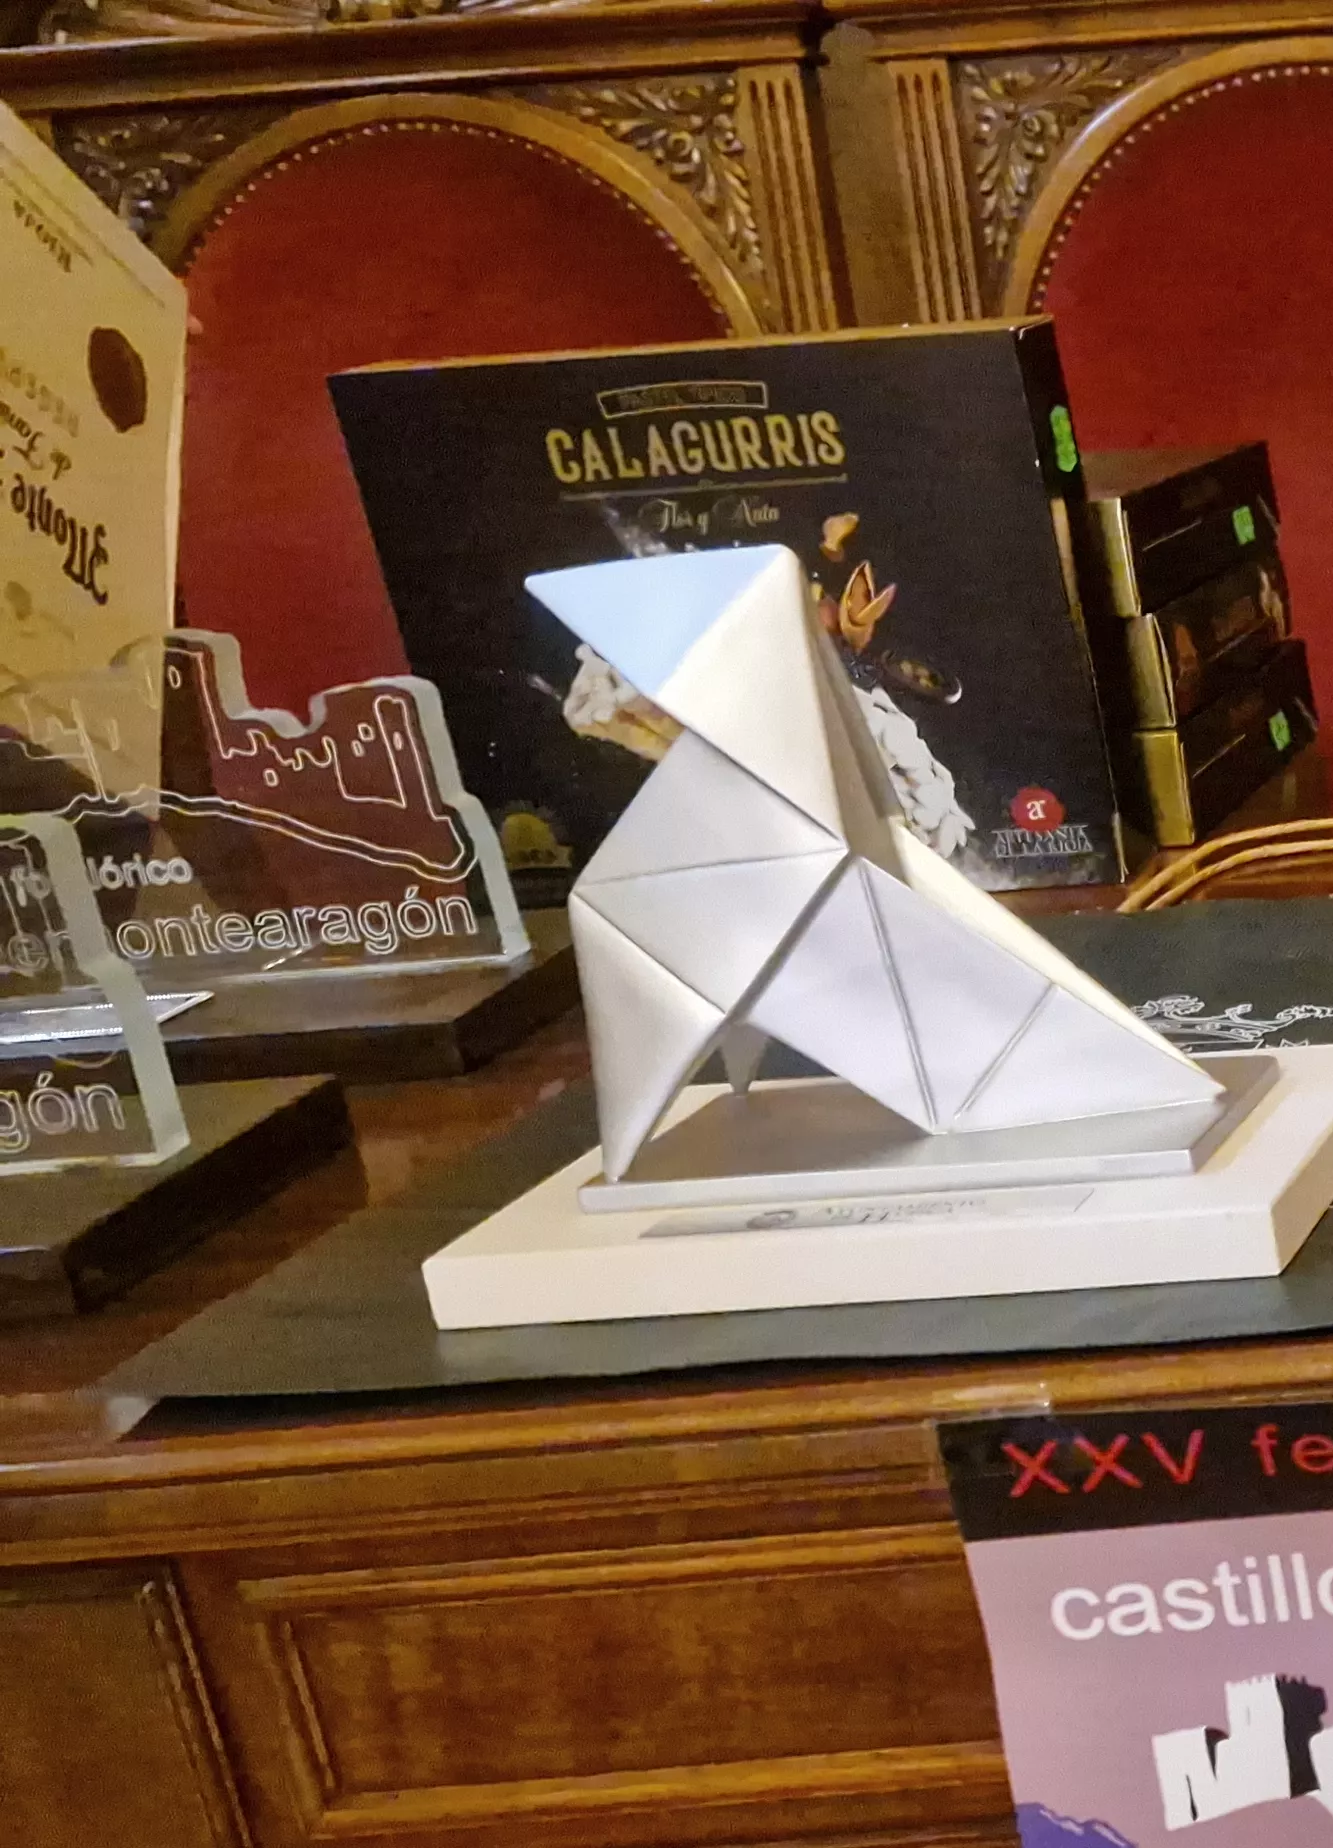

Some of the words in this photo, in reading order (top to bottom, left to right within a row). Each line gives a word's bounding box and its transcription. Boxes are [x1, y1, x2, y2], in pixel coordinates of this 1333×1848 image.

[545, 411, 846, 483] CALAGURRIS
[103, 885, 480, 960] ontearagón
[1002, 1428, 1204, 1498] XXV
